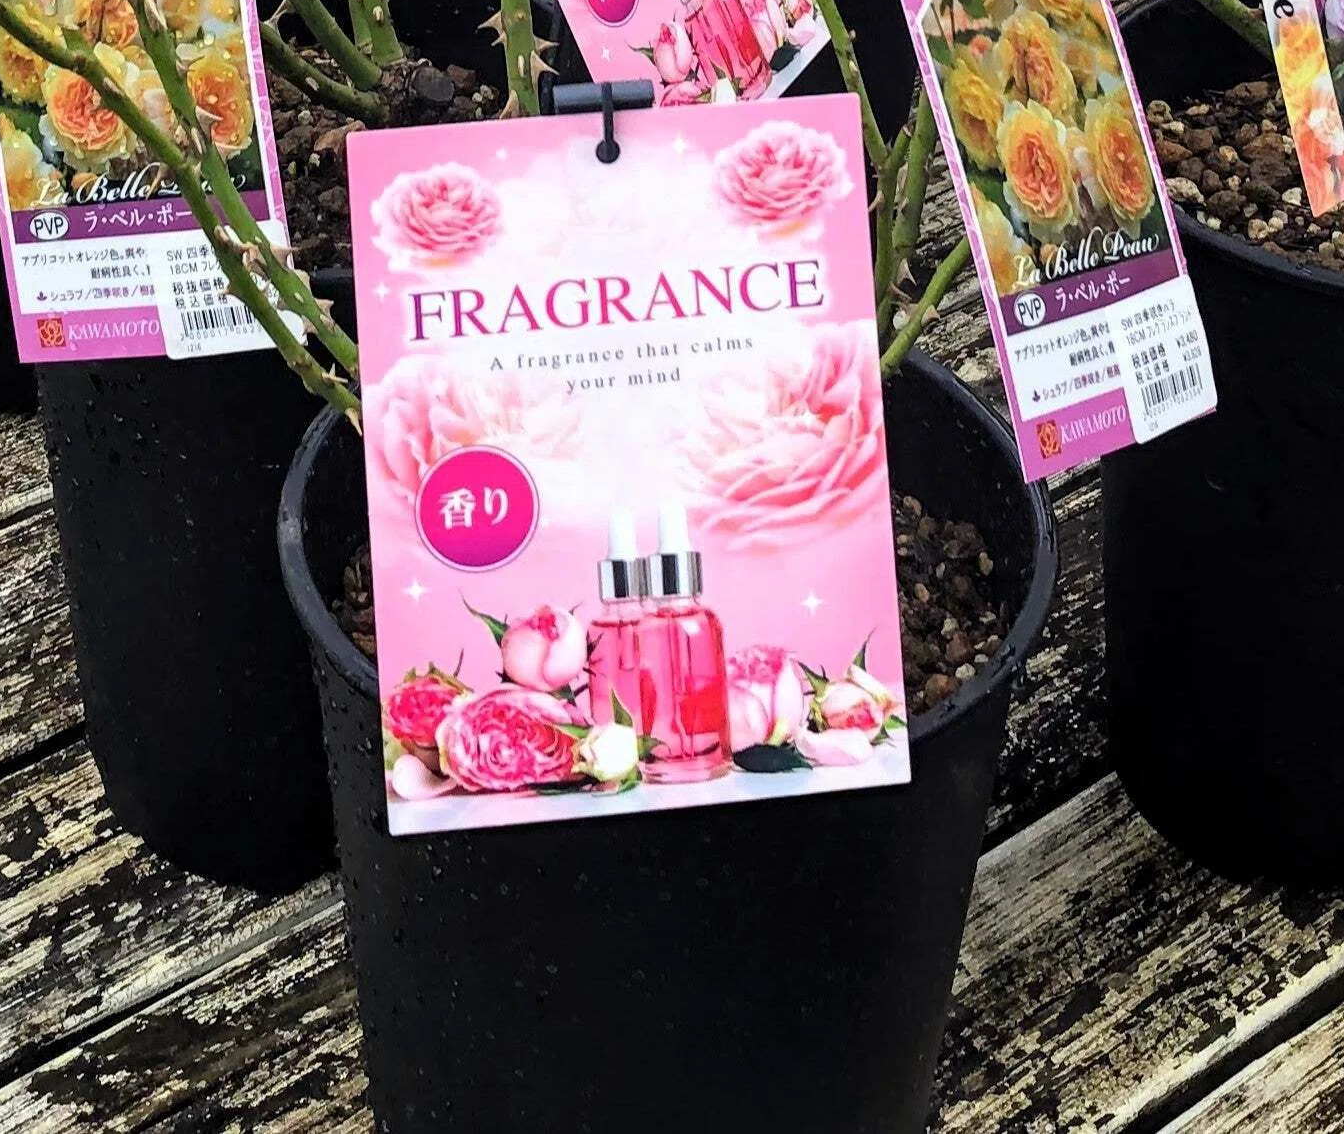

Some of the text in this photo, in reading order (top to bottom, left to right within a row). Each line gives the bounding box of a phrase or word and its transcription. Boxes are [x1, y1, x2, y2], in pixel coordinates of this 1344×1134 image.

[76, 162, 160, 203] Belle
[34, 216, 64, 237] PVP
[166, 250, 183, 263] SW
[169, 262, 198, 275] 18CM
[1045, 226, 1104, 280] Belle
[408, 259, 825, 341] FRAGRANCE
[1018, 297, 1042, 324] PVP
[68, 319, 160, 341] KAWAMOTO
[489, 335, 754, 371] A fragrance that calms
[566, 366, 682, 394] your mind
[1061, 405, 1127, 444] KAWAMOTO
[438, 487, 509, 530] 香り
